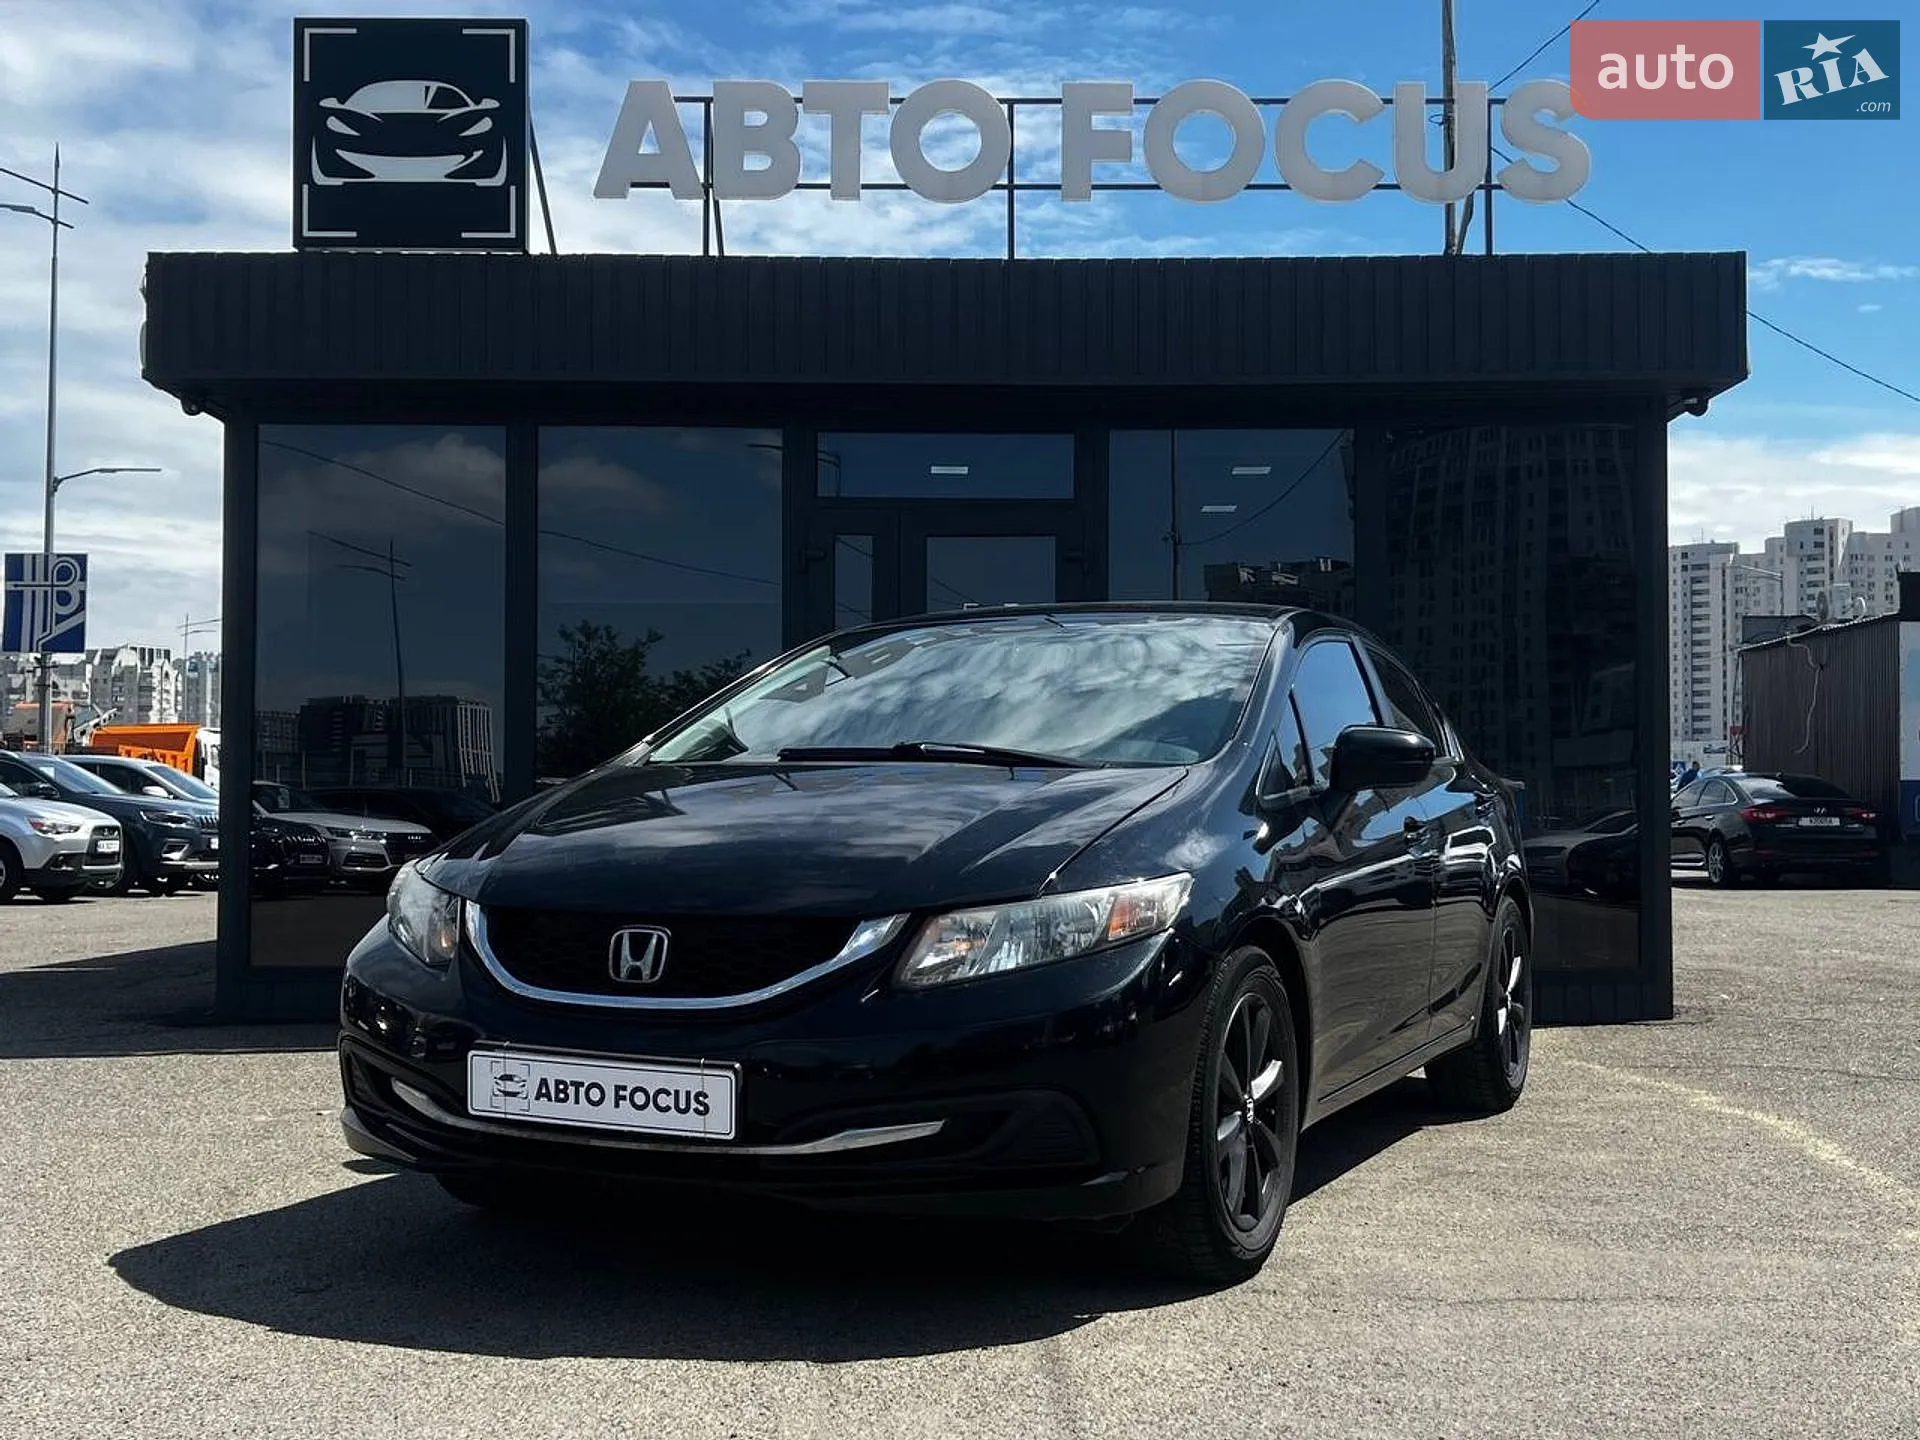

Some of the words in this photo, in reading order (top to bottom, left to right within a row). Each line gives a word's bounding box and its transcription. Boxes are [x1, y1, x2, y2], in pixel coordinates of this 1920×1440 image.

[593, 79, 1012, 204] АВТО
[1060, 79, 1592, 204] FOCUS
[534, 1077, 606, 1107] АВТО
[613, 1084, 710, 1117] FOCUS
